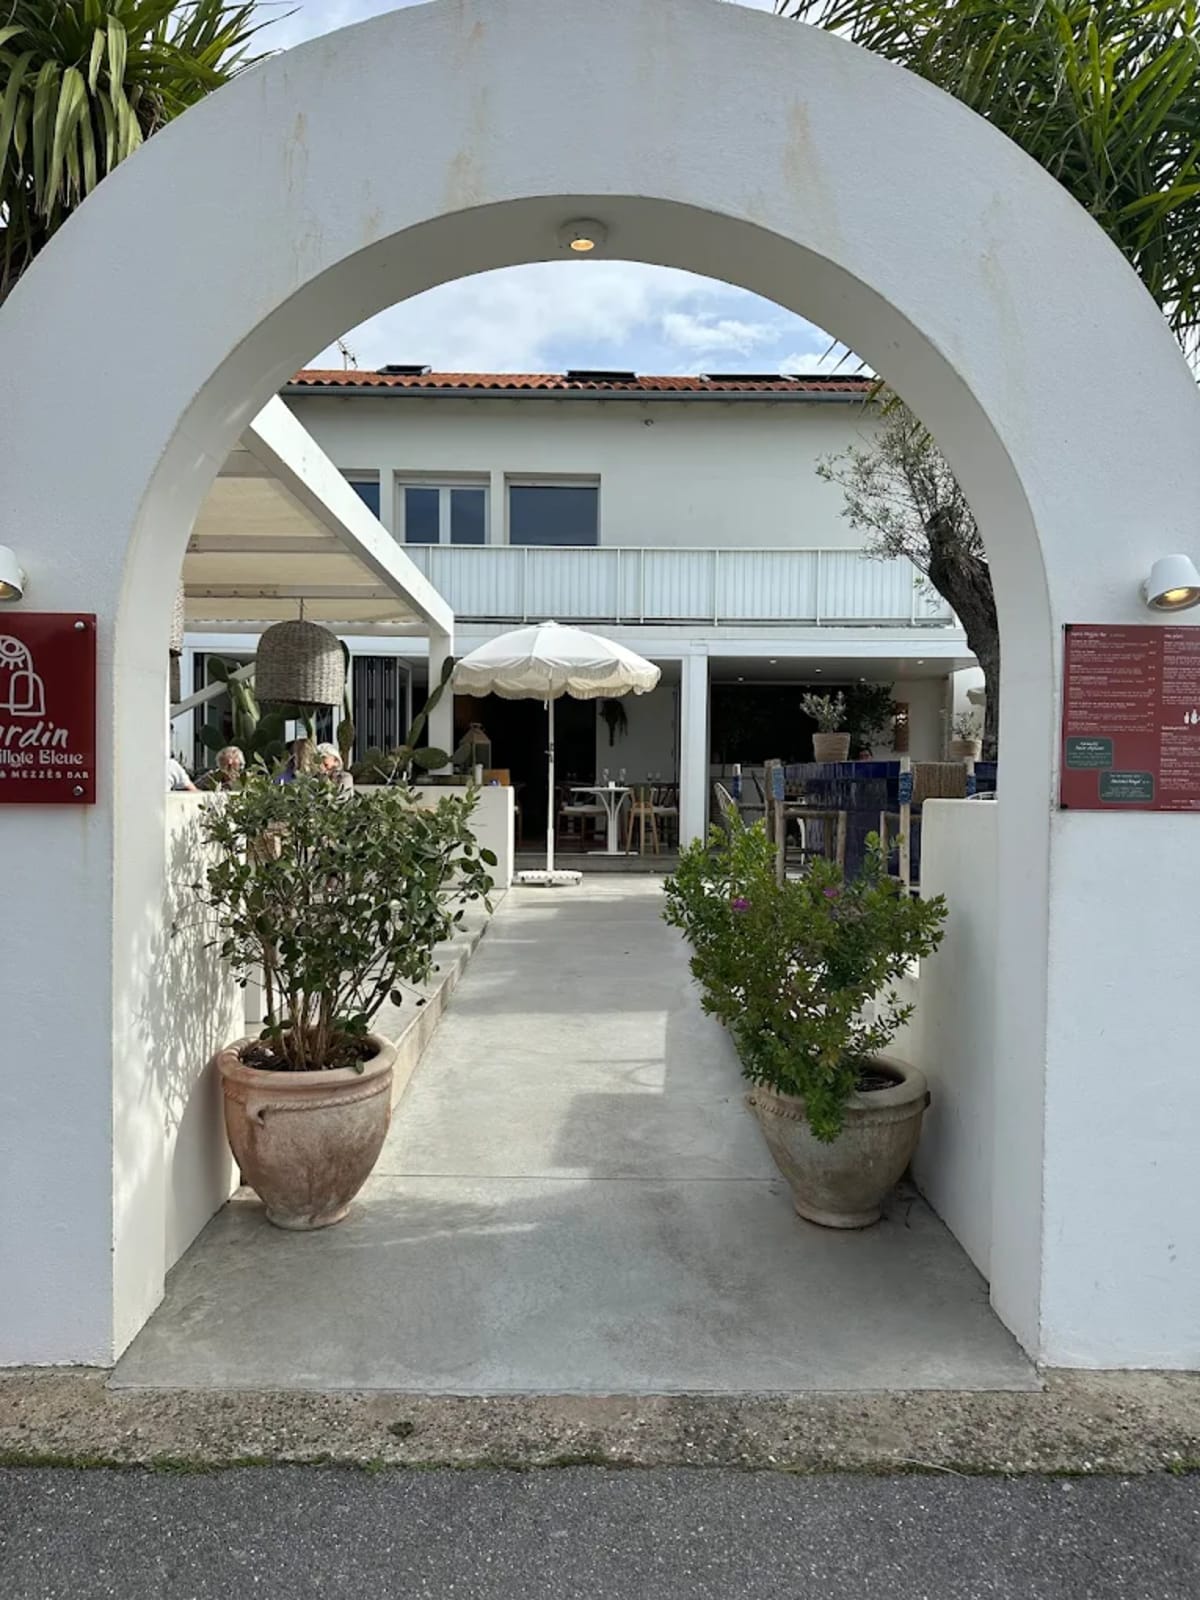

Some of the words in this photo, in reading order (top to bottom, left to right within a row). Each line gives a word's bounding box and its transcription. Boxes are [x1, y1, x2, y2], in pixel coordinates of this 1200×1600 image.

[0, 721, 69, 748] rdin
[39, 749, 83, 765] Bleue
[66, 770, 89, 779] BAR
